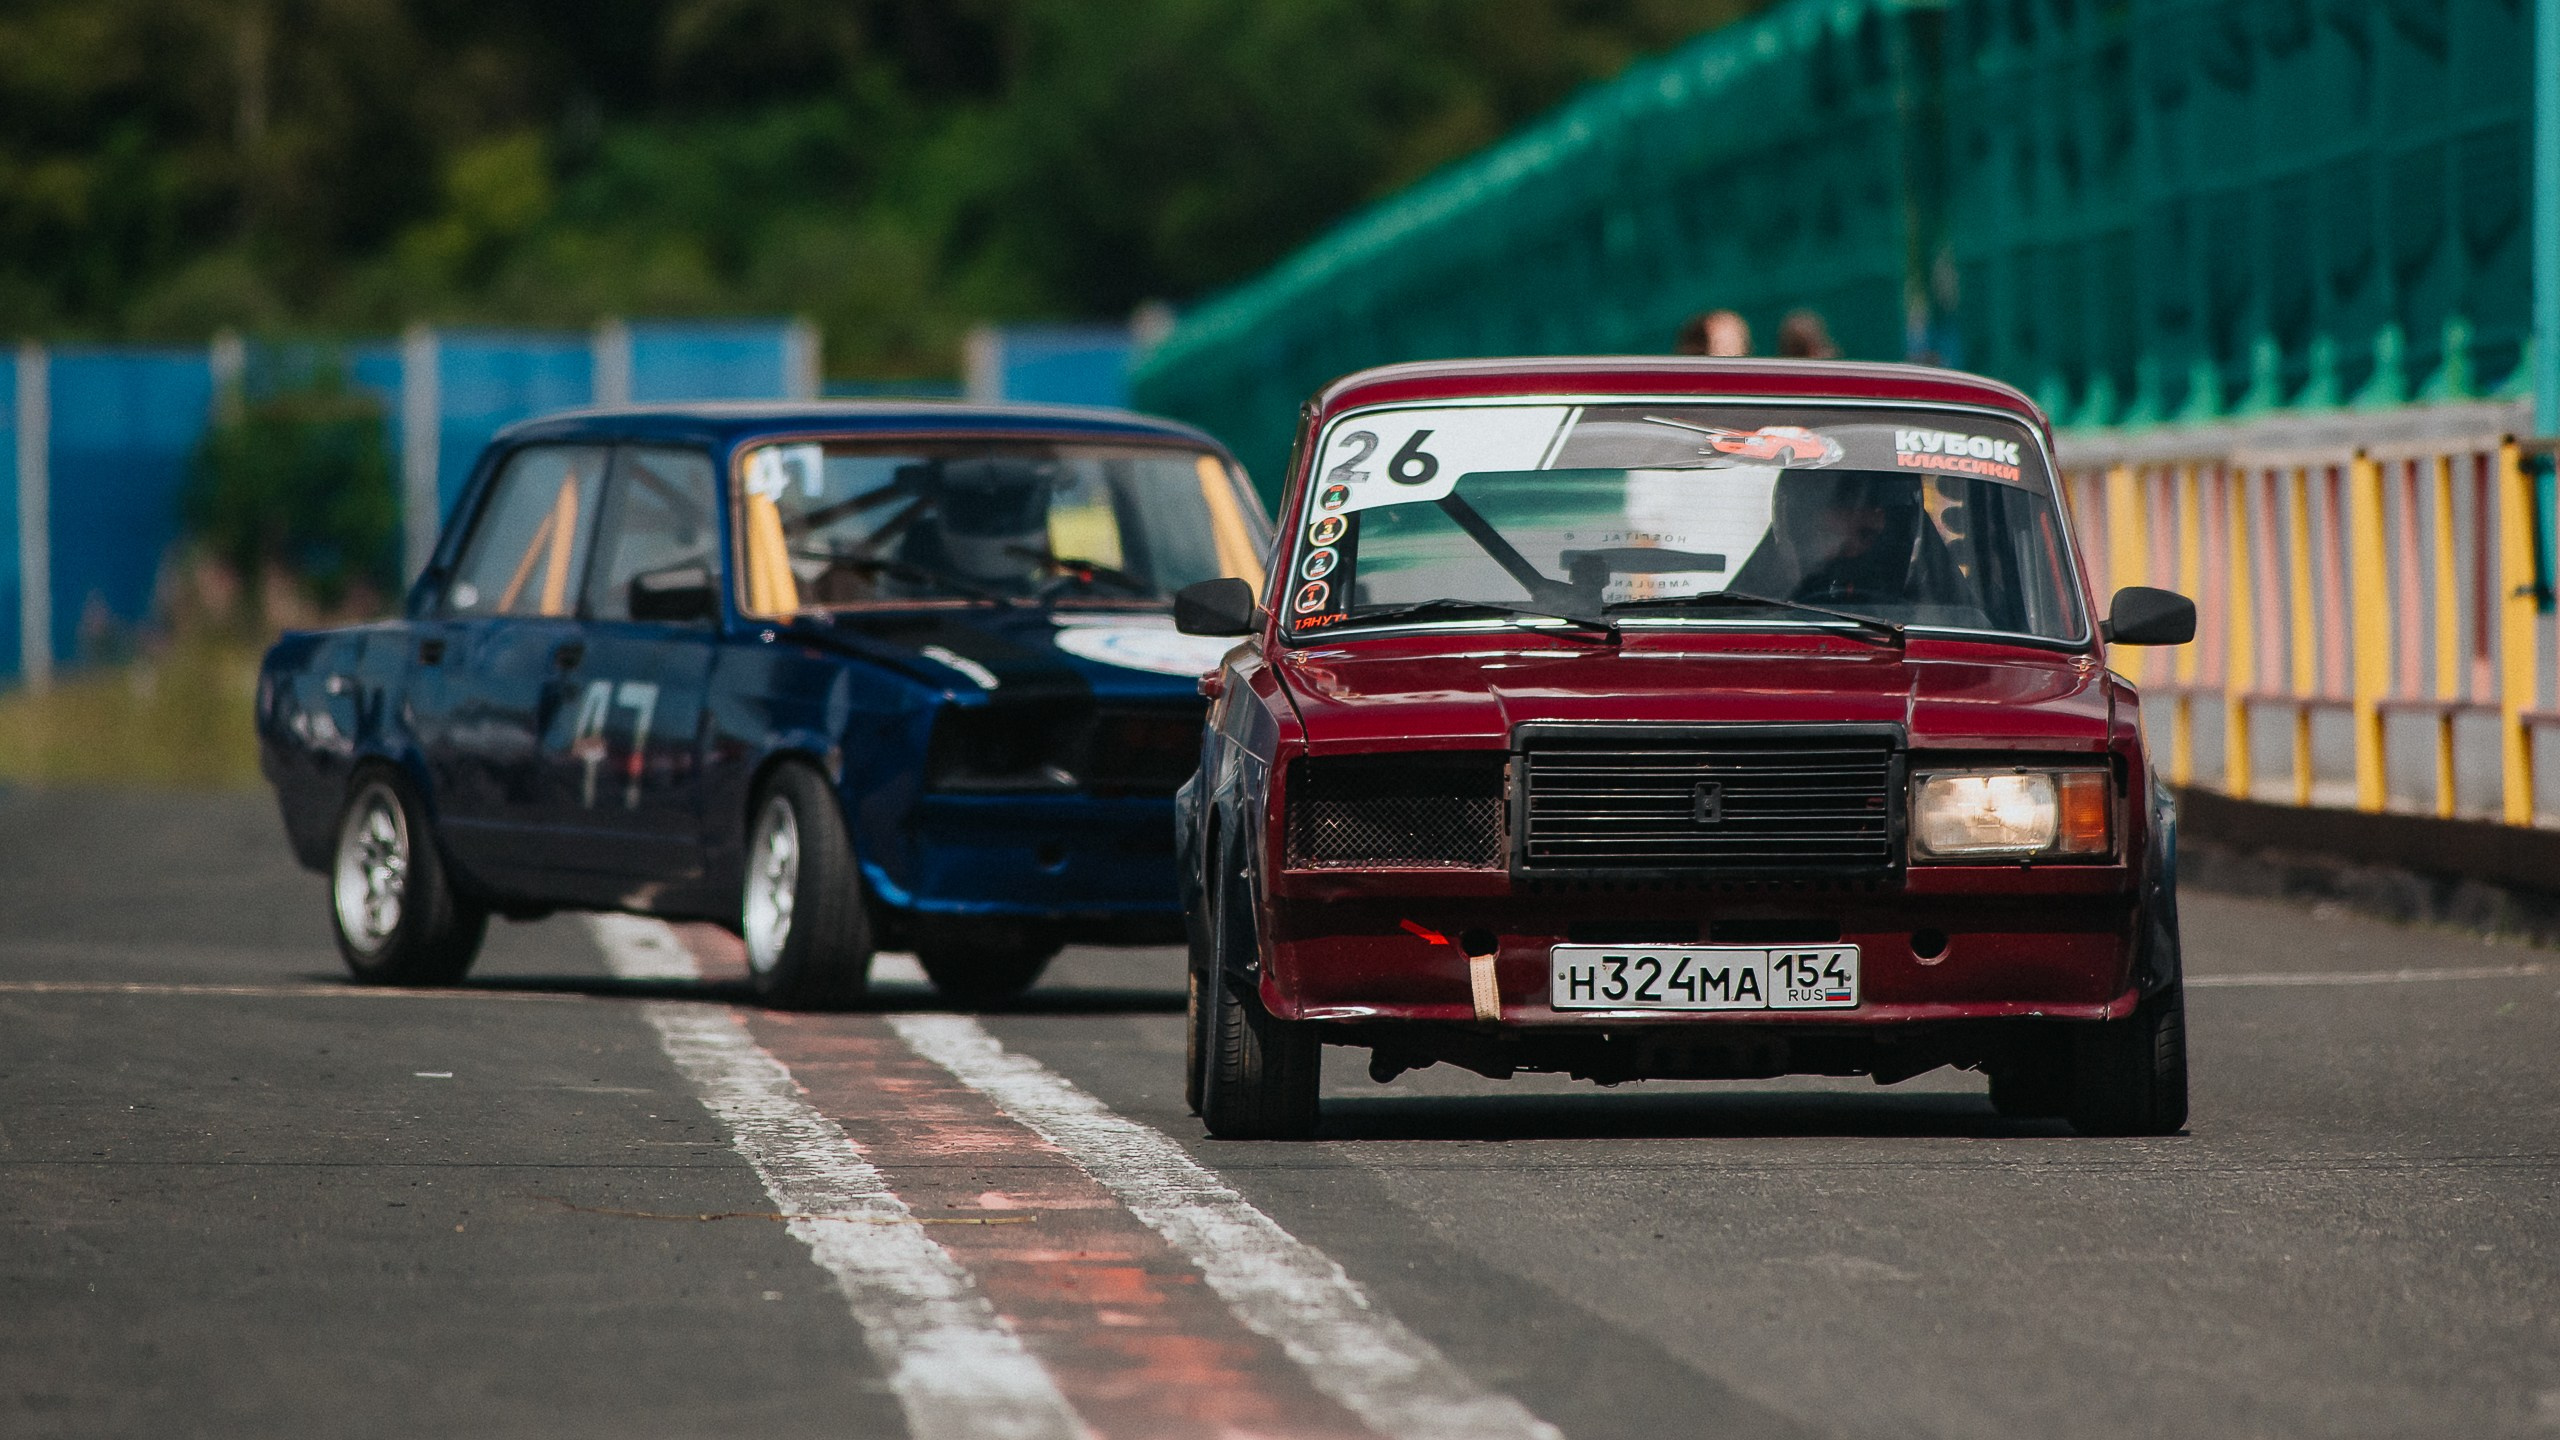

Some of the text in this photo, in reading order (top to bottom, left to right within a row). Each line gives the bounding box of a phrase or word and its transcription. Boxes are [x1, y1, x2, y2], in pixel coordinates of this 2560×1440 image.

[1326, 430, 1438, 484] 26
[1895, 429, 2020, 465] КУБОК
[745, 446, 824, 501] 47
[1897, 453, 2020, 481] КЛАССИКИ
[571, 679, 661, 809] 47
[1773, 953, 1845, 988] 154
[1788, 989, 1824, 1002] RUS
